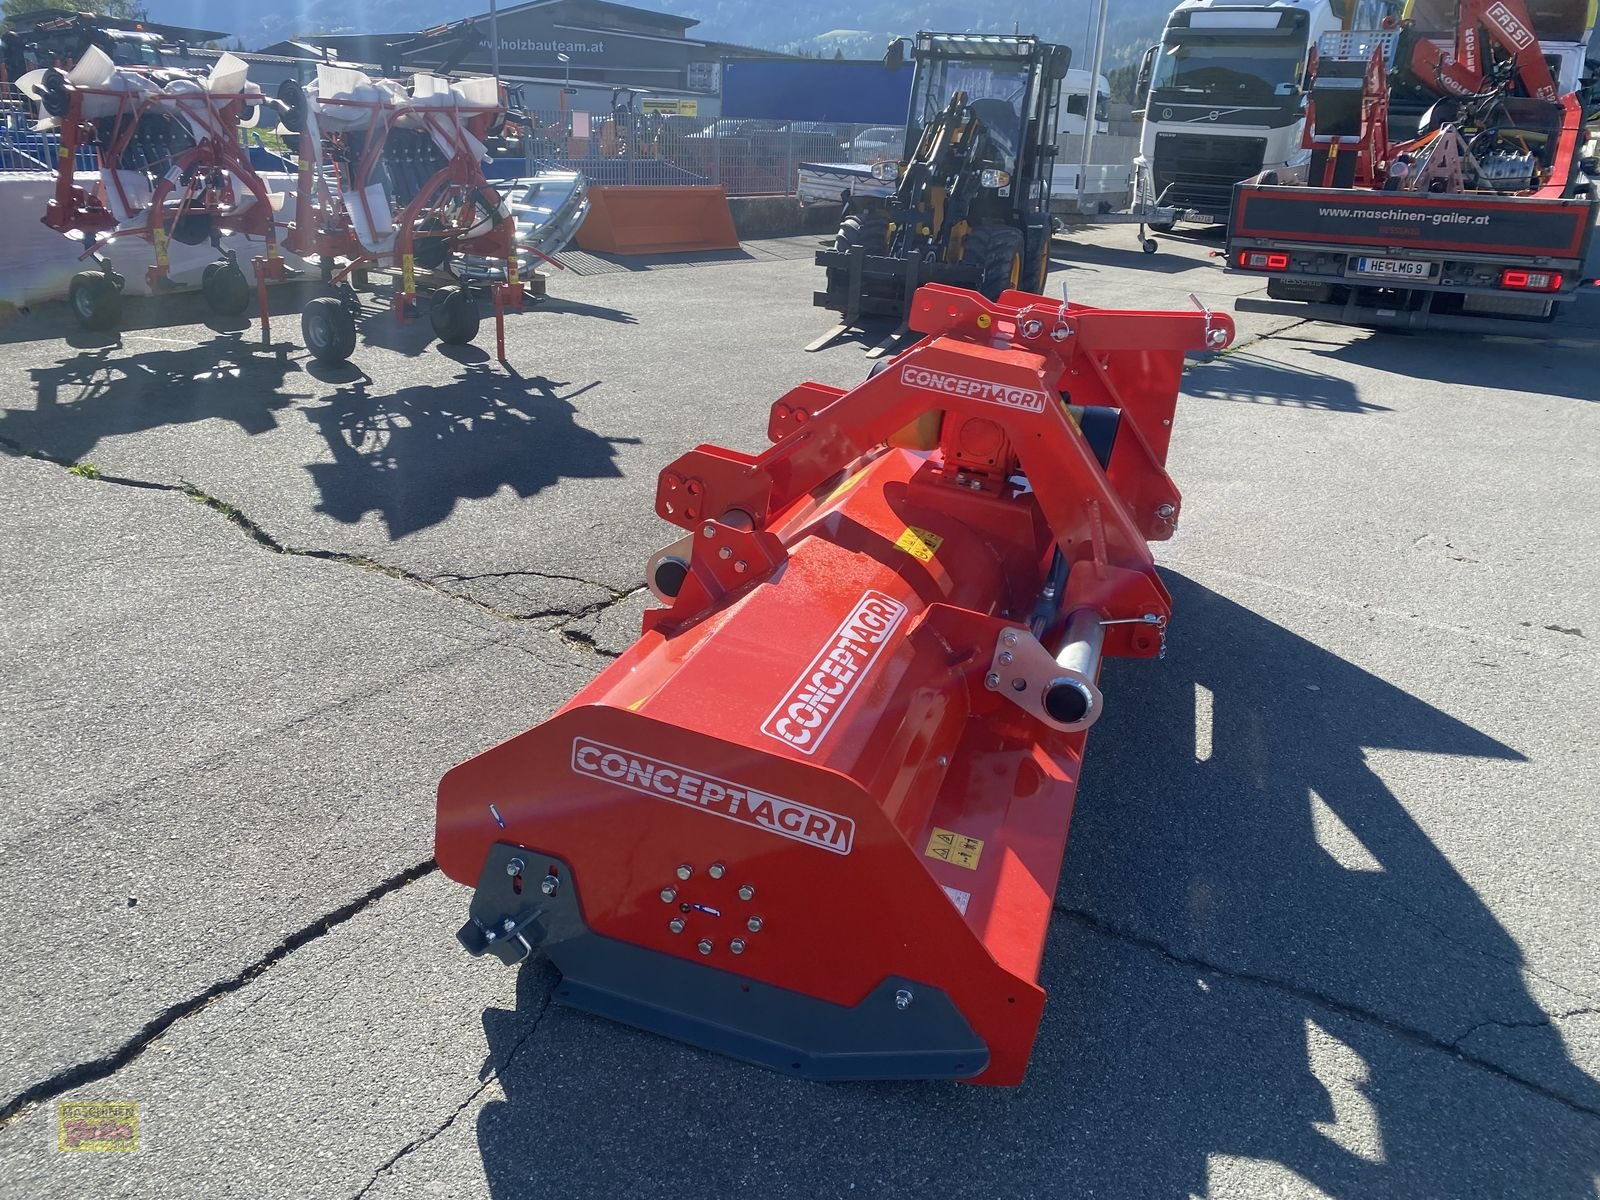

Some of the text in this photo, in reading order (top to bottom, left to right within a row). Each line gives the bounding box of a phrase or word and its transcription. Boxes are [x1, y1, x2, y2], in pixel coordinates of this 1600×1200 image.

[1491, 7, 1529, 45] FASSI
[1319, 207, 1491, 226] www.maschinen-gailer.at
[1371, 260, 1423, 275] HE LMG 9
